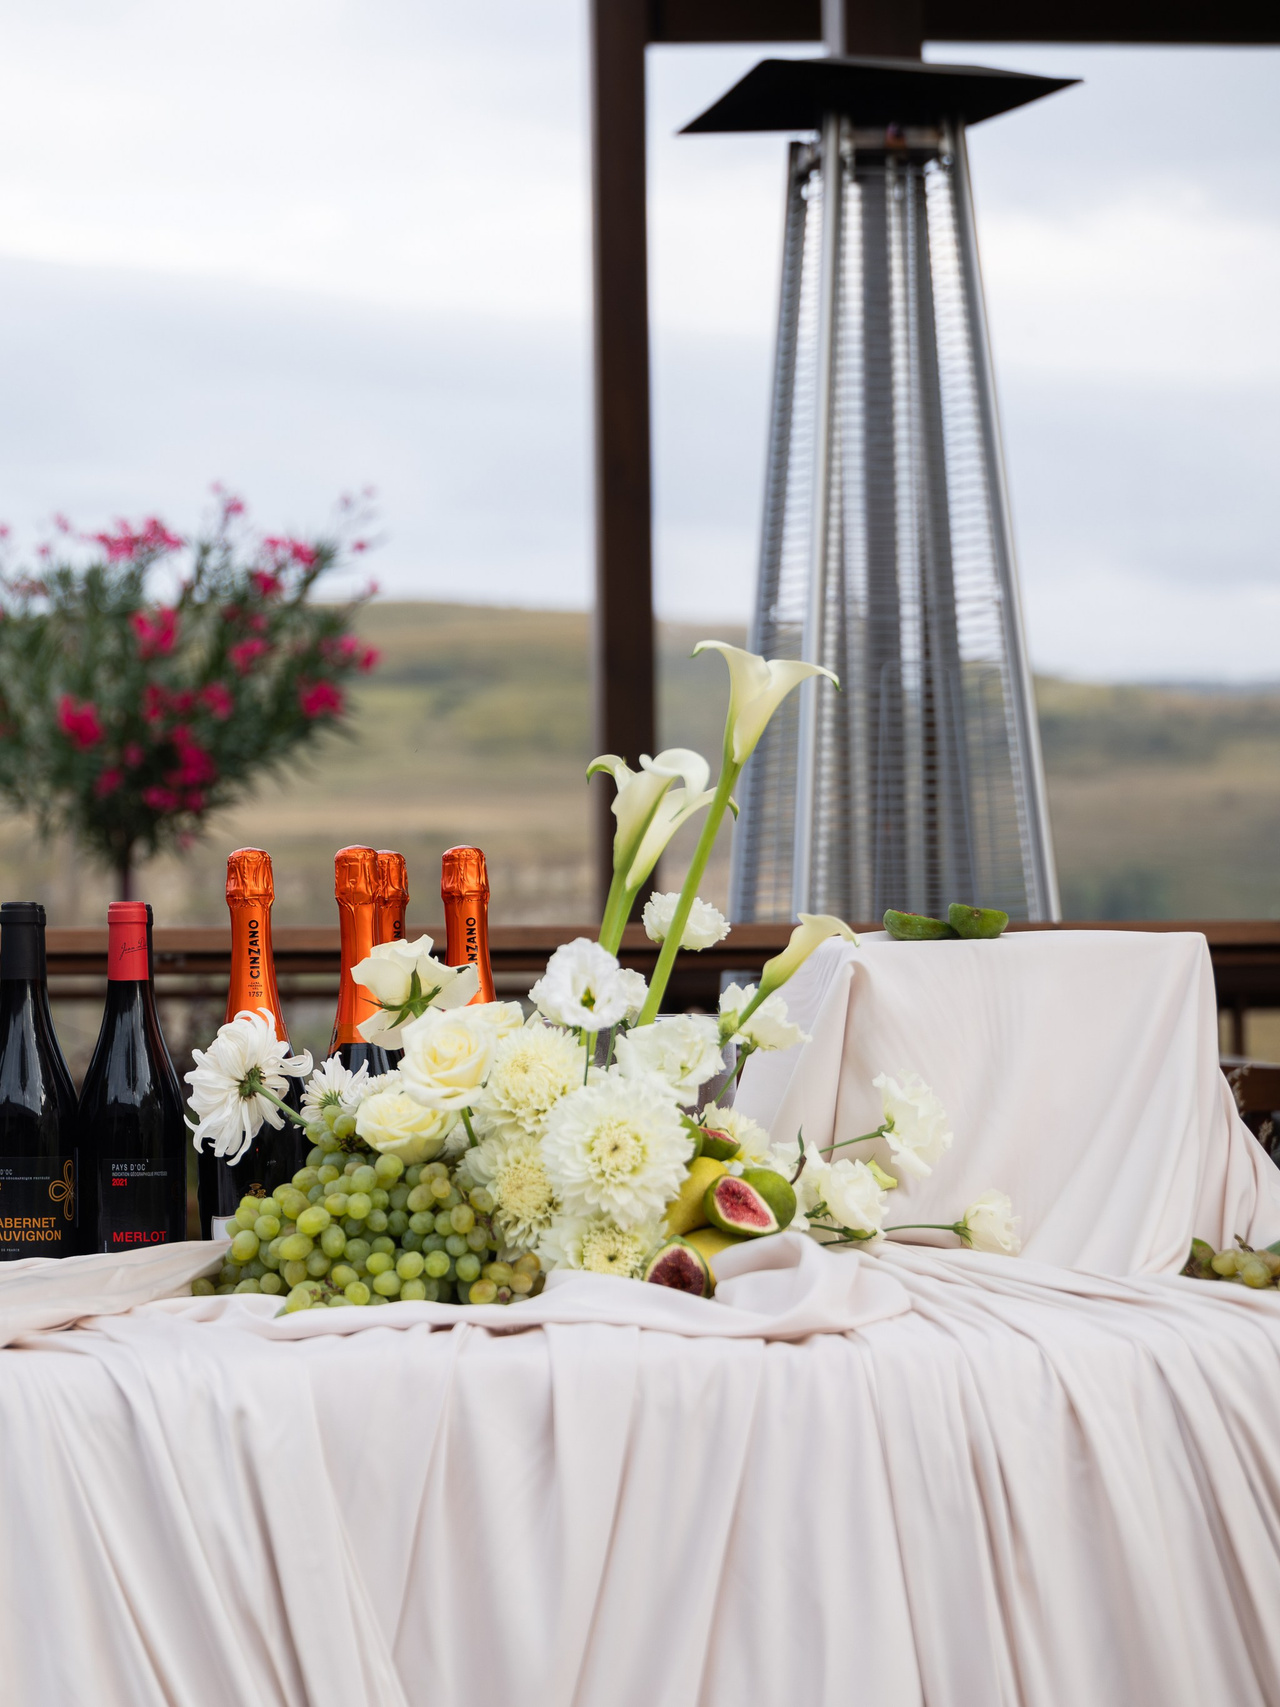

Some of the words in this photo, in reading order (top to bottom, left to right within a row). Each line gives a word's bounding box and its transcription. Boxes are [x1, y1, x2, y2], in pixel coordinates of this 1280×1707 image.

[465, 917, 478, 964] NZANO
[248, 920, 261, 979] CINZANO
[111, 1163, 128, 1171] PAYS
[130, 1163, 146, 1171] D'OC
[112, 1178, 127, 1186] 2021
[112, 1231, 167, 1242] MERLOT
